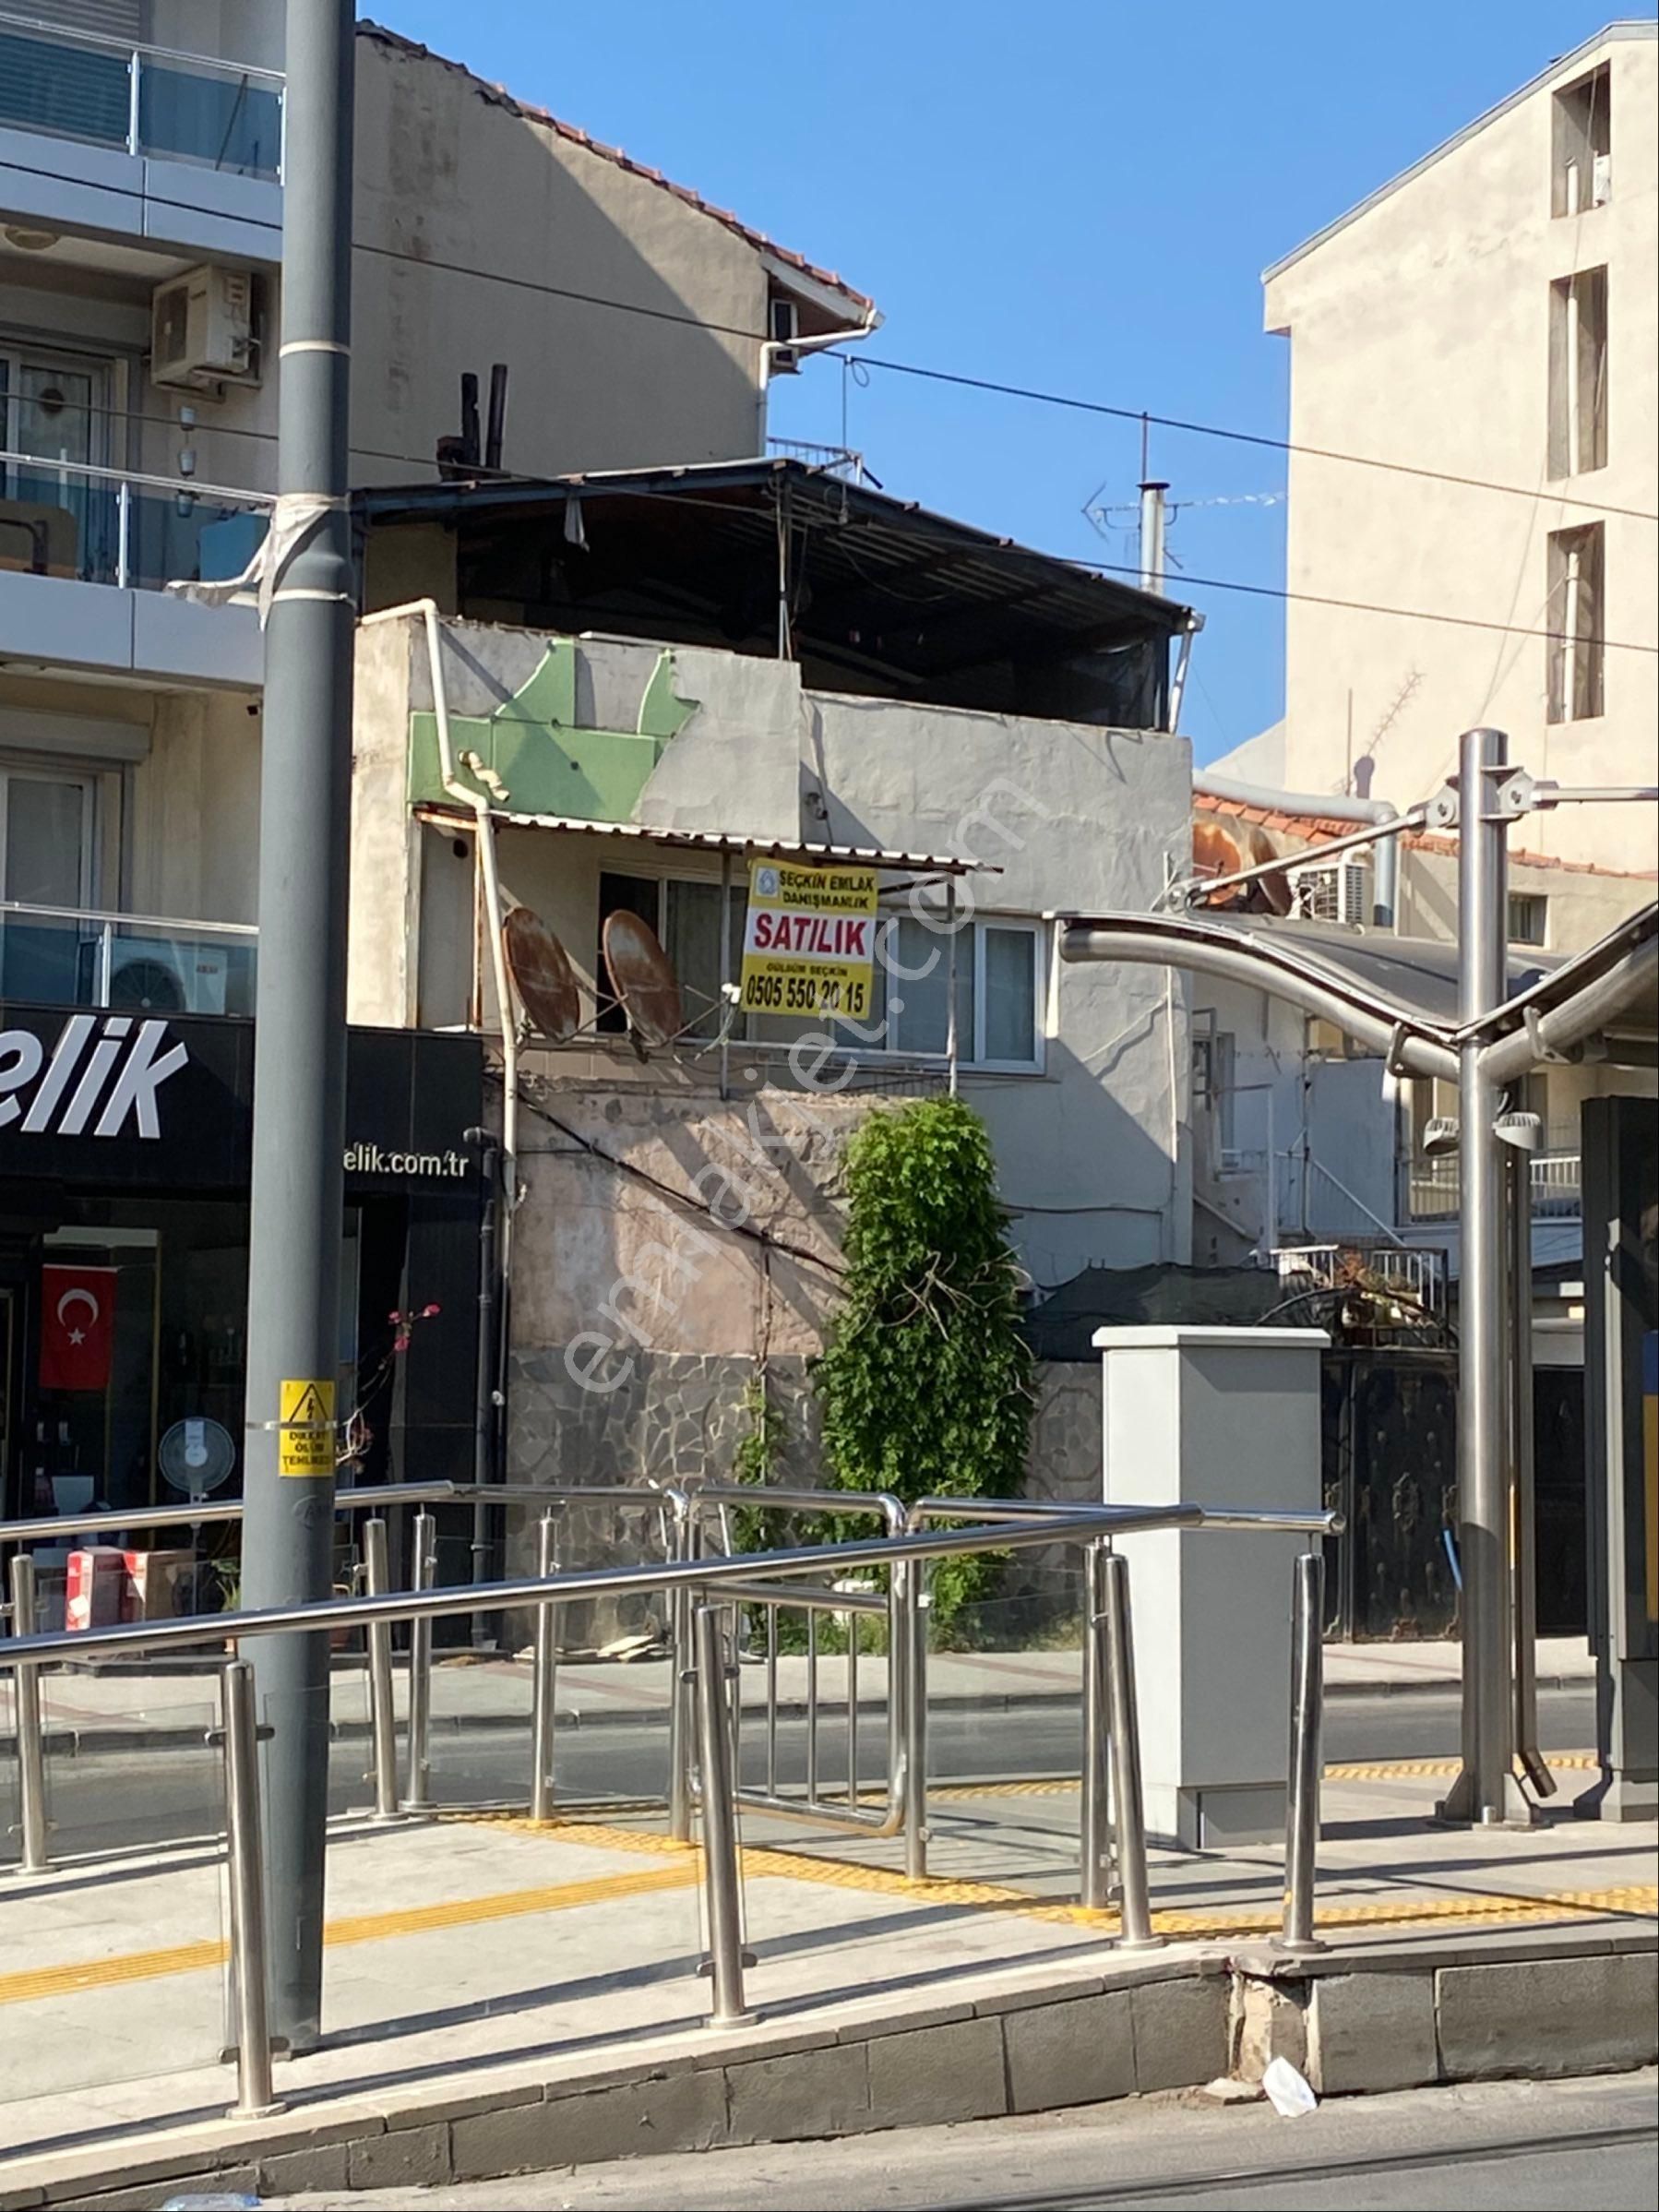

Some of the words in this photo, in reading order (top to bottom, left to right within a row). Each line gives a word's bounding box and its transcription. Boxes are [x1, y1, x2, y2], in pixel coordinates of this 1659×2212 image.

[780, 870, 826, 891] SEÇKİN
[830, 875, 876, 891] EMLAK
[783, 891, 868, 909] DANIŞMANLIK
[754, 913, 867, 956] SATILIK
[746, 974, 782, 1007] 0505
[786, 977, 817, 1010] 550
[820, 980, 841, 1011] 20
[846, 982, 864, 1012] 15
[0, 1015, 189, 1140] elik
[343, 1144, 469, 1178] elik.com.tr
